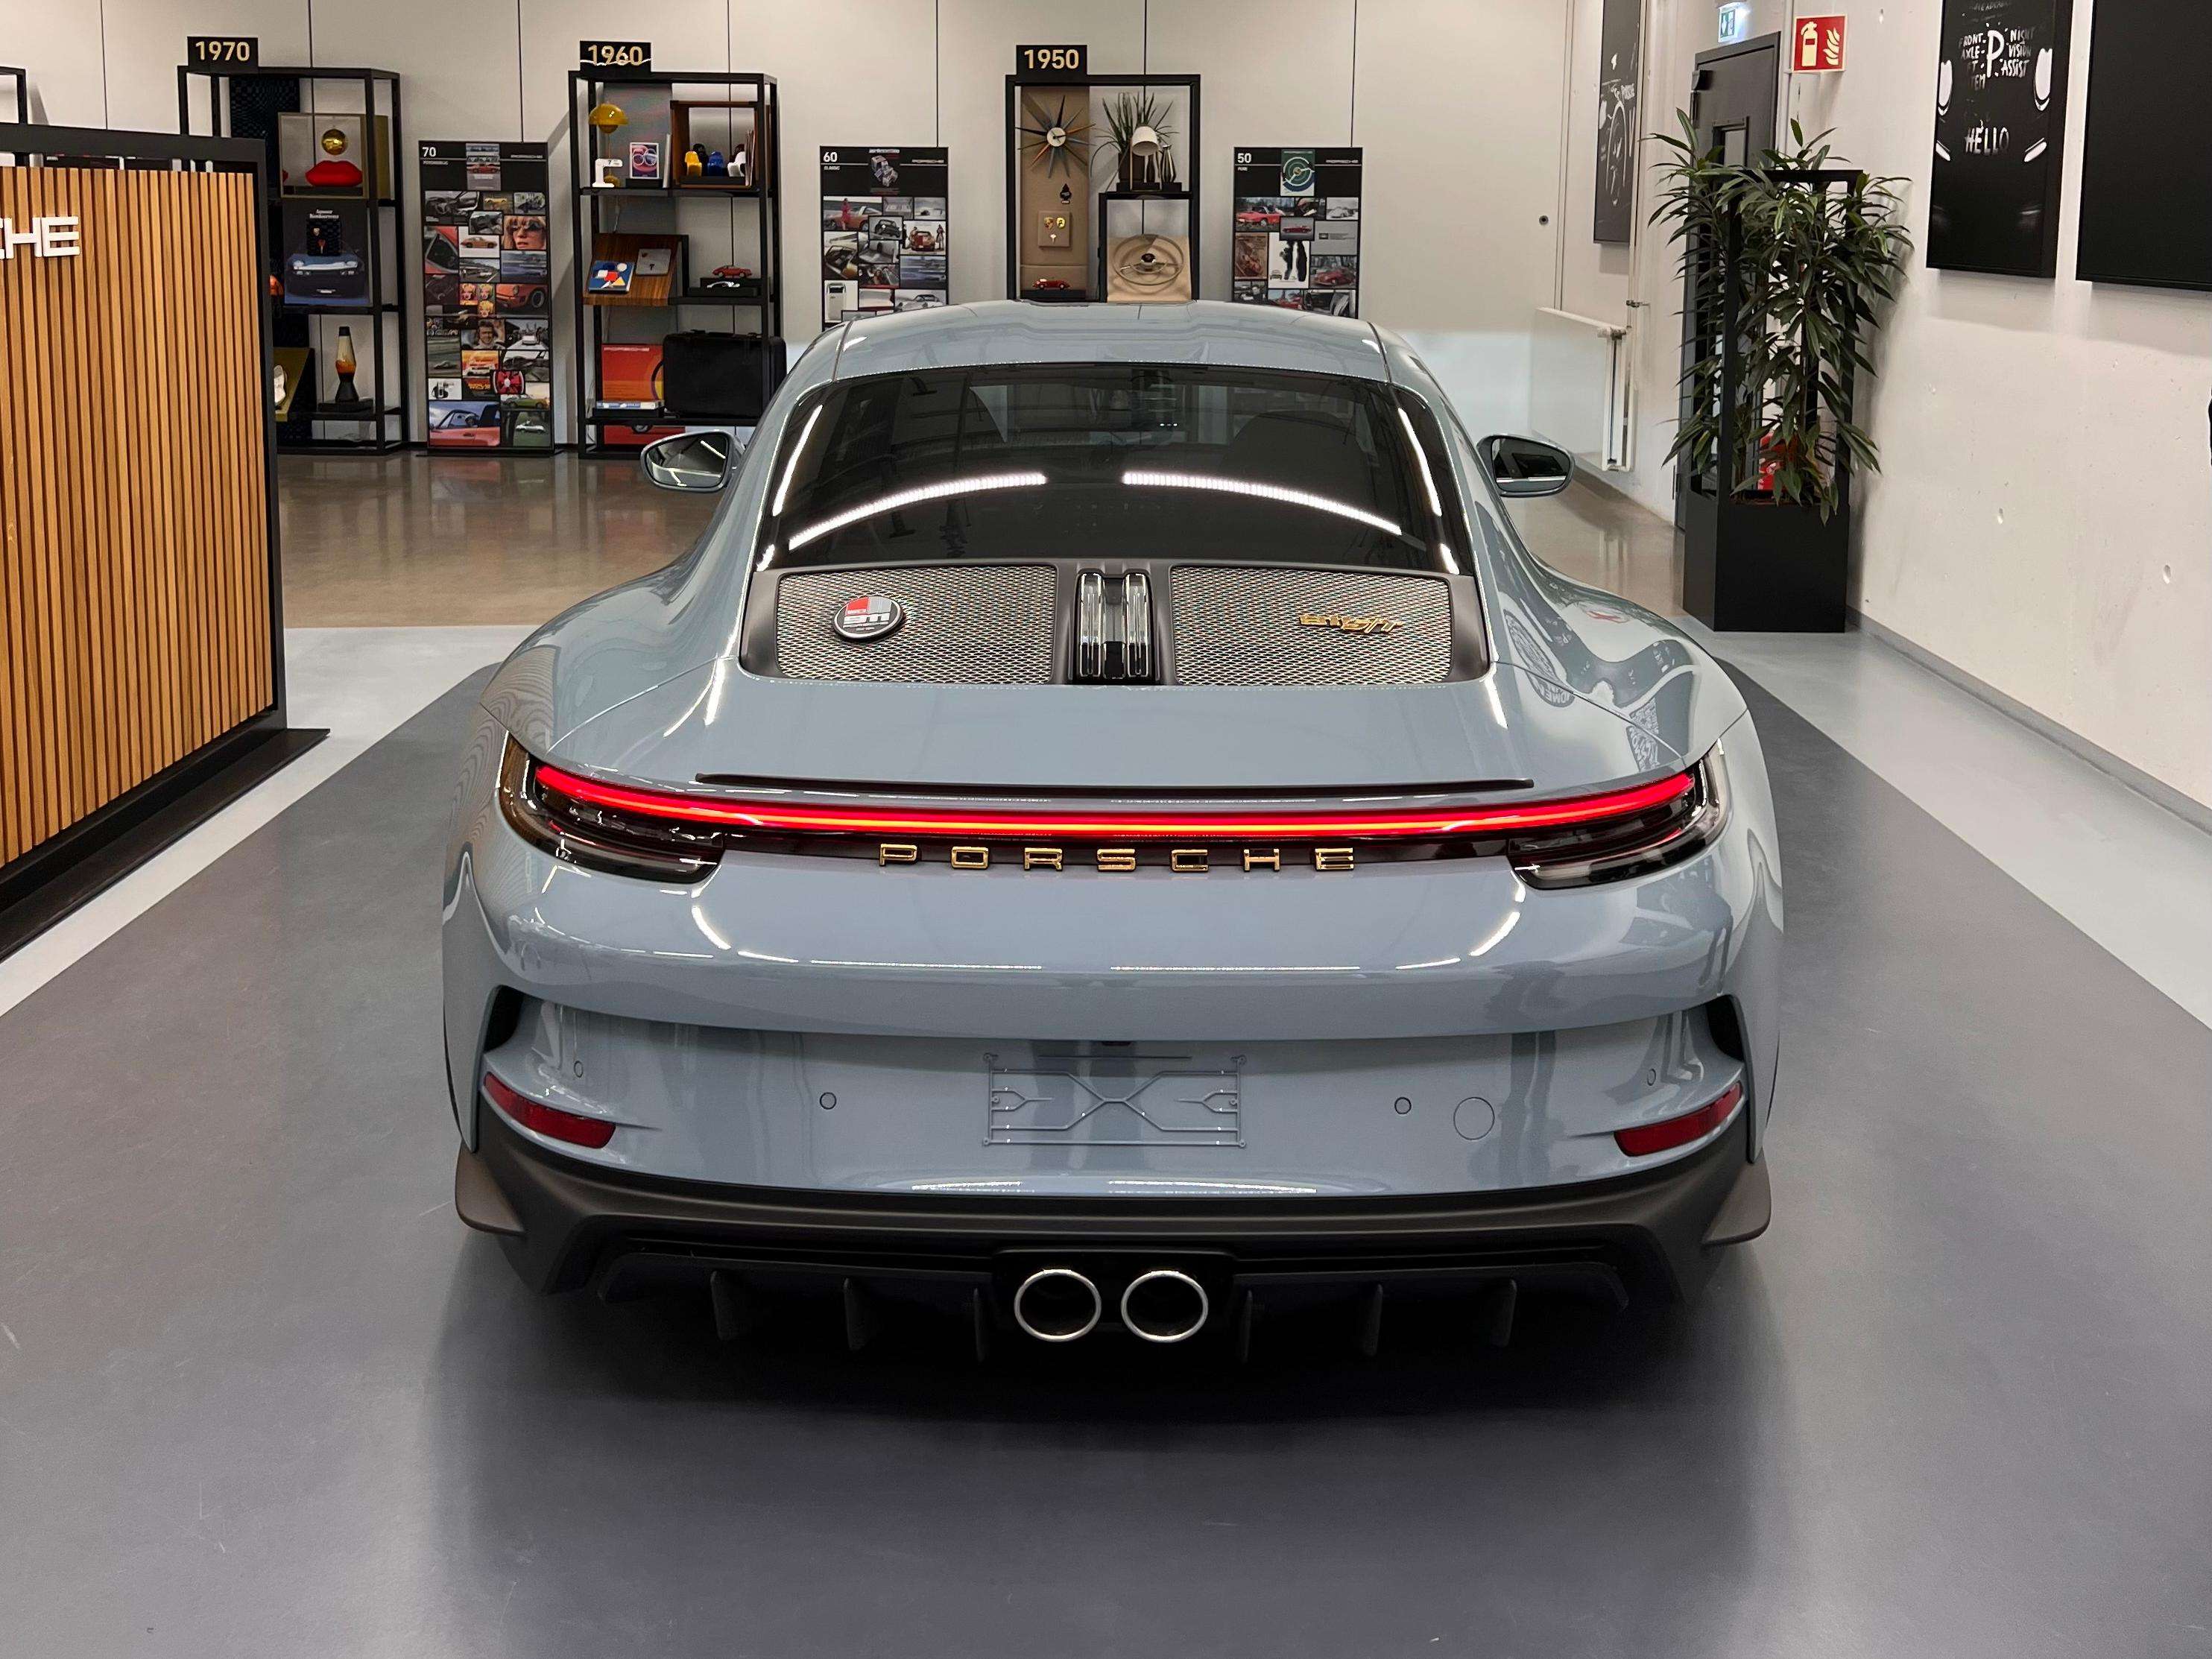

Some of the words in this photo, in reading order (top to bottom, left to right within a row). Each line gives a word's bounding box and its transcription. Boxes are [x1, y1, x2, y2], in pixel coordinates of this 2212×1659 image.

[195, 41, 250, 61] 1970
[588, 45, 643, 66] 1960
[1024, 48, 1079, 69] 1950
[1961, 45, 1980, 60] AXLE
[1986, 29, 2005, 78] P
[2001, 58, 2030, 78] ASSIST
[1964, 125, 2010, 155] HELLO
[422, 146, 437, 157] 70
[823, 151, 838, 162] 60
[1237, 153, 1252, 163] 50
[0, 216, 80, 259] HE
[879, 843, 1354, 873] PORSCHE
